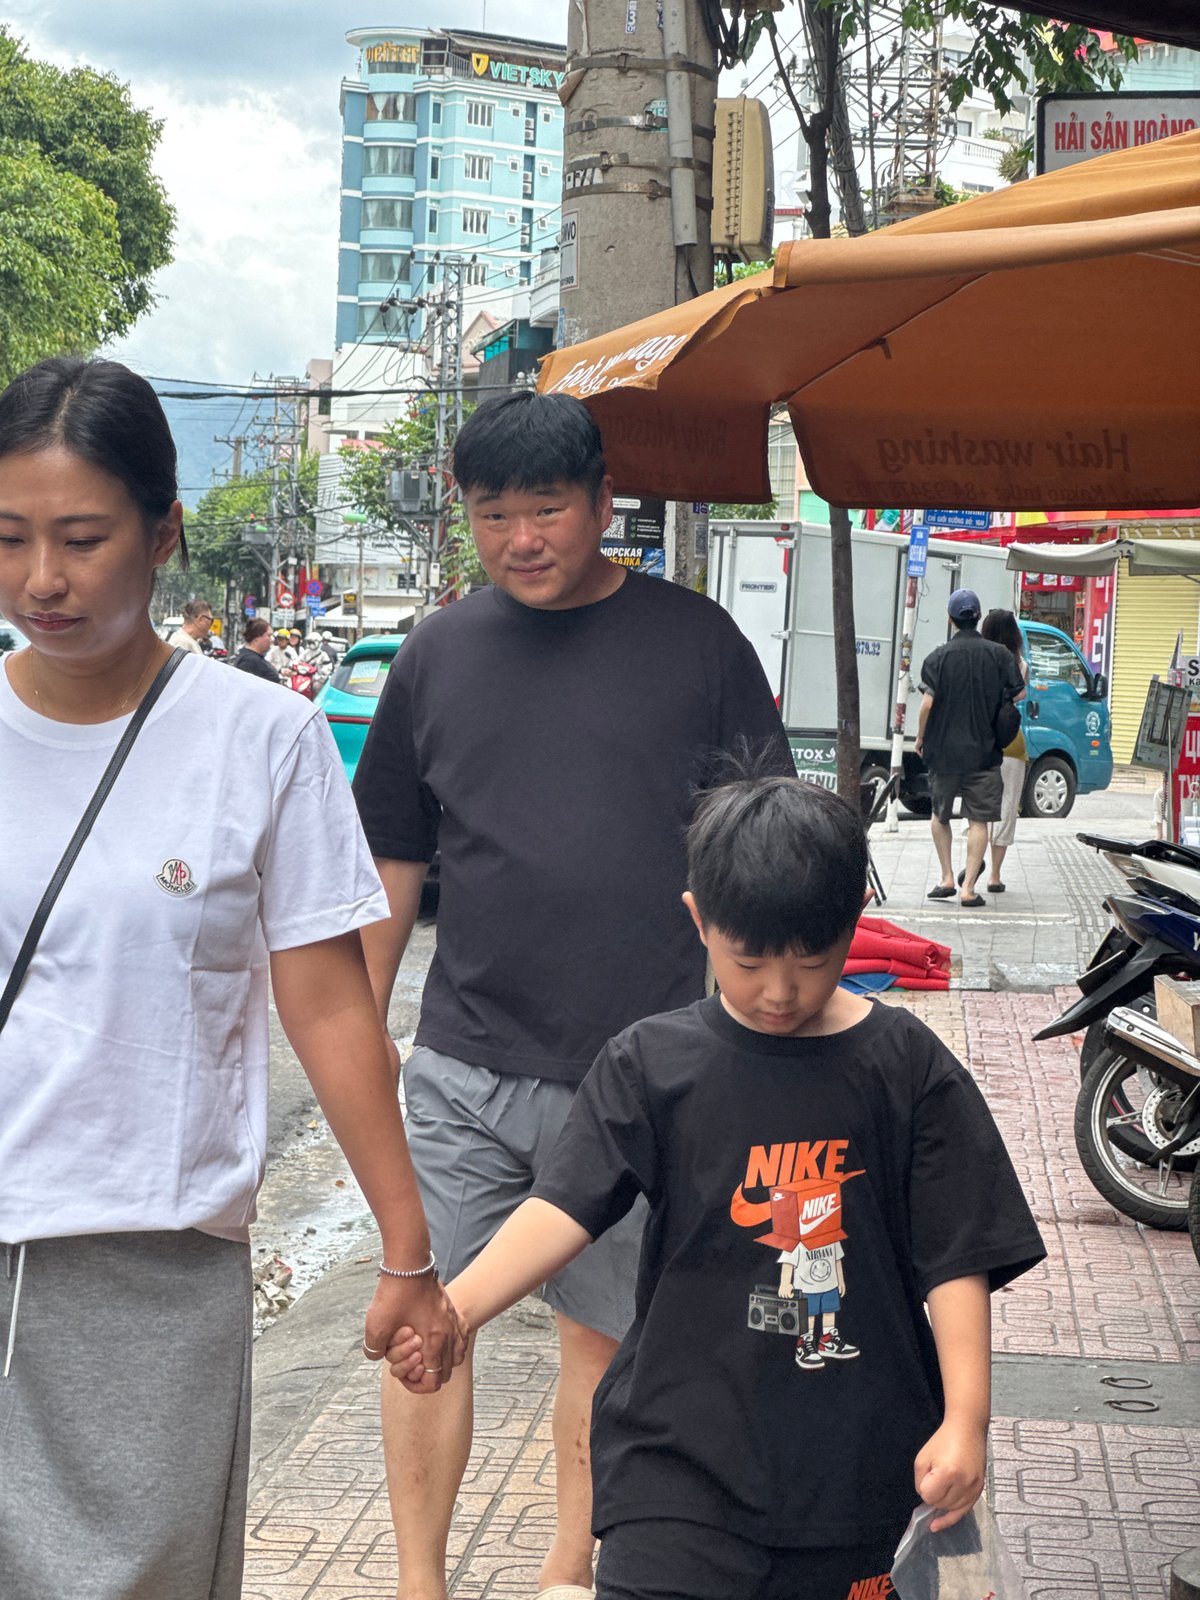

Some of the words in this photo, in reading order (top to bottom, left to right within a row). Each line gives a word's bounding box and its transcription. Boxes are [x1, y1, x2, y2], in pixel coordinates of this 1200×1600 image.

[489, 60, 565, 90] VIETSKY
[1055, 112, 1086, 150] HẢI
[1090, 111, 1128, 150] SẢN
[600, 547, 643, 557] МОРСКАЯ
[609, 556, 641, 567] БАЛКА
[744, 1139, 850, 1189] NIKE
[801, 1193, 837, 1220] NIKE
[847, 1573, 893, 1600] NIKE
